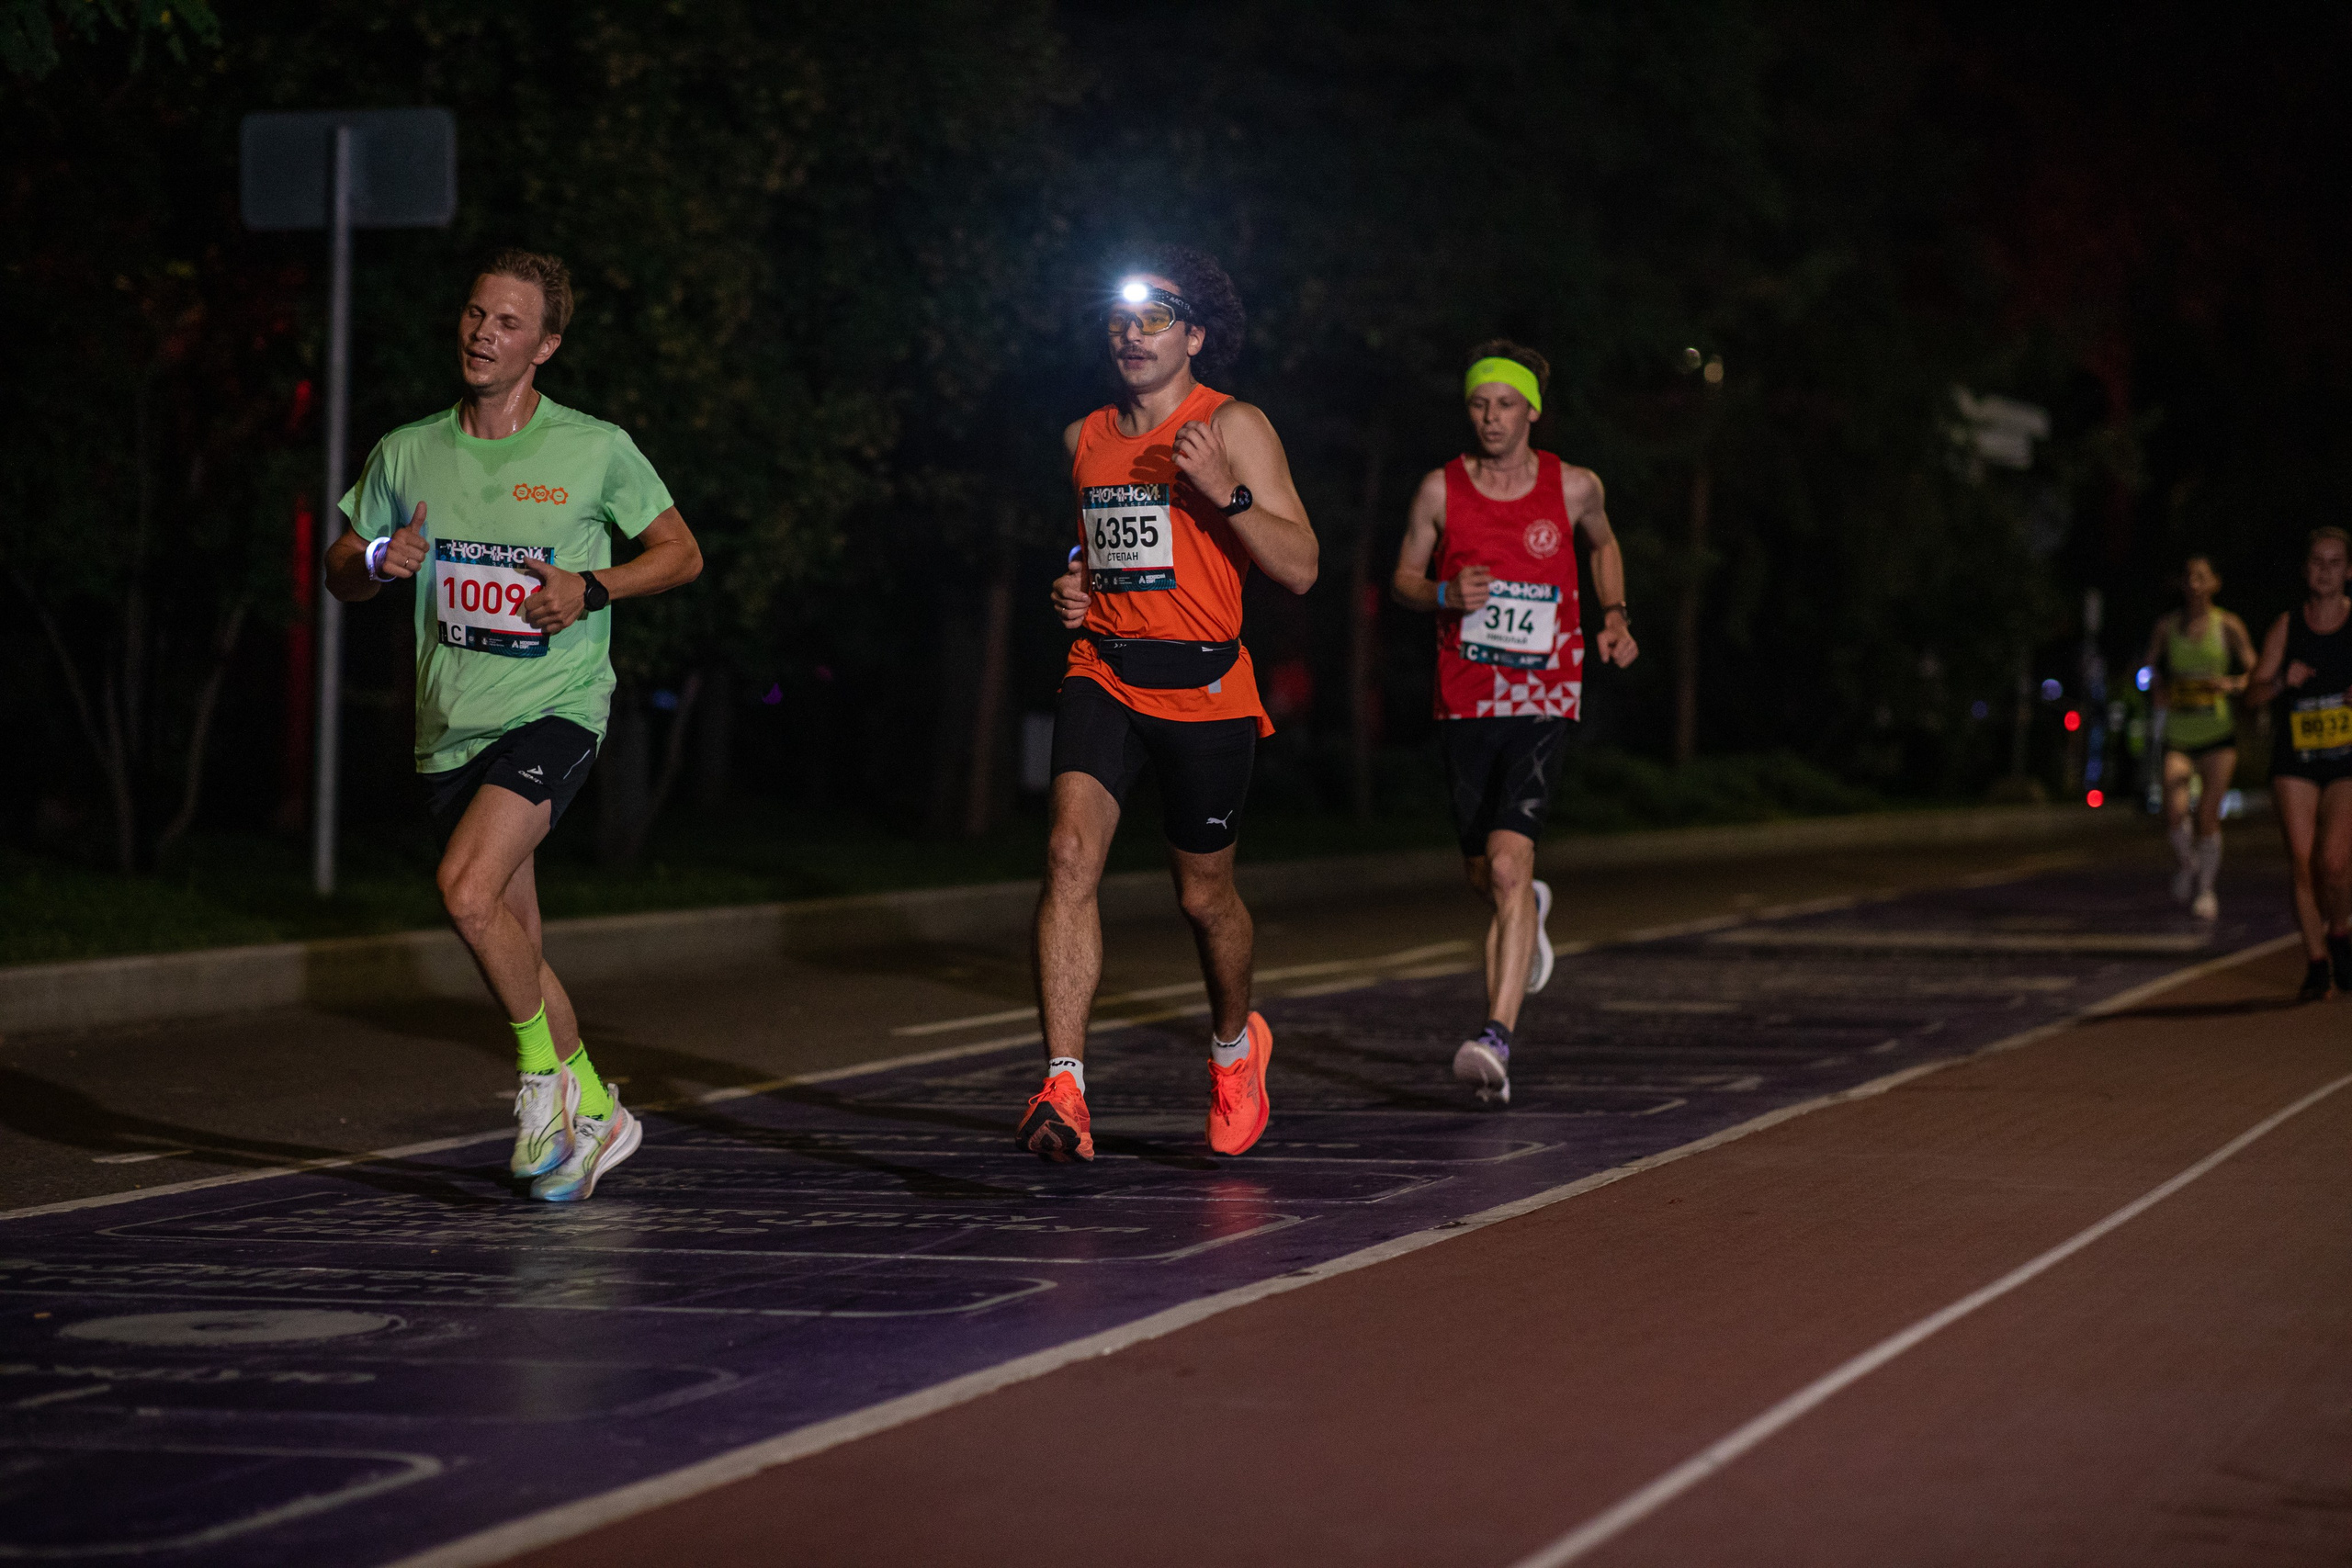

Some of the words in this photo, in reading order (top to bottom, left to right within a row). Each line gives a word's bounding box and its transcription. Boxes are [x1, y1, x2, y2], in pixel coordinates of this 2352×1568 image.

[1091, 484, 1160, 504] НОЧНОЙ
[1094, 515, 1159, 549] 6355
[450, 539, 544, 564] НОЧНОЙ
[1107, 551, 1138, 562] СТЕПАН
[443, 577, 544, 616] 1009
[1488, 580, 1553, 600] ОЧНОЙ
[1485, 605, 1534, 634] 314
